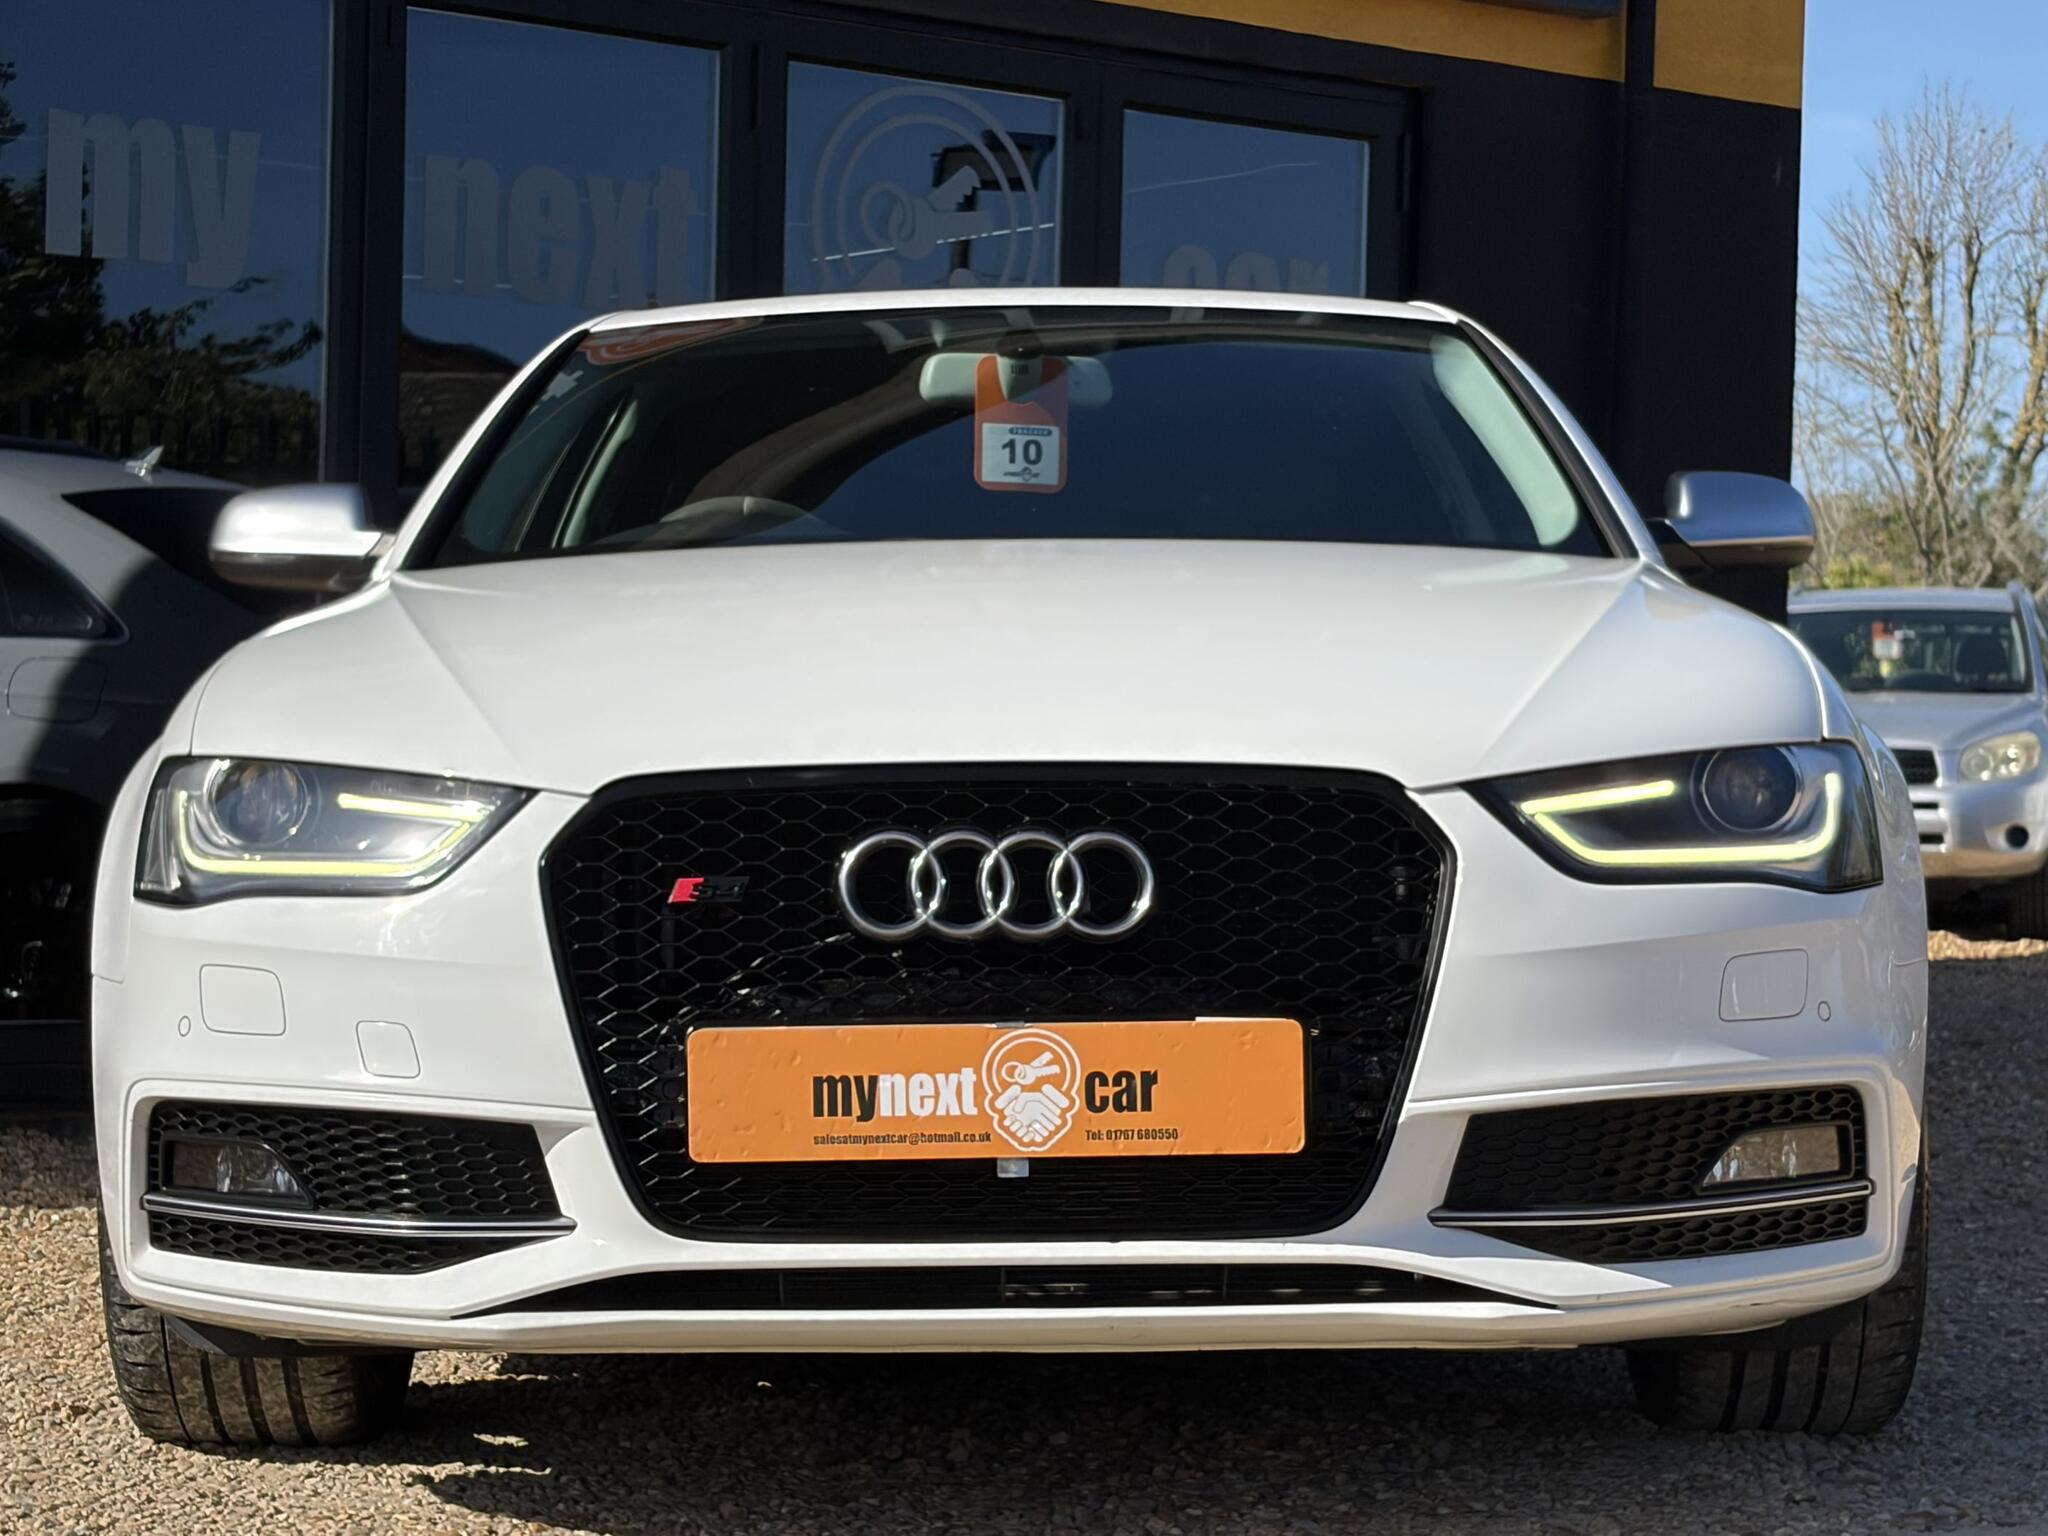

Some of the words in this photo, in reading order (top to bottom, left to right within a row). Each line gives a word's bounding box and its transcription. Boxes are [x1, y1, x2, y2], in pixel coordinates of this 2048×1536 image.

[44, 107, 261, 288] my
[422, 154, 698, 310] next
[1001, 438, 1043, 466] 10
[1084, 1069, 1159, 1114] car
[1084, 1129, 1105, 1141] Tel:
[1136, 1127, 1179, 1141] 680550
